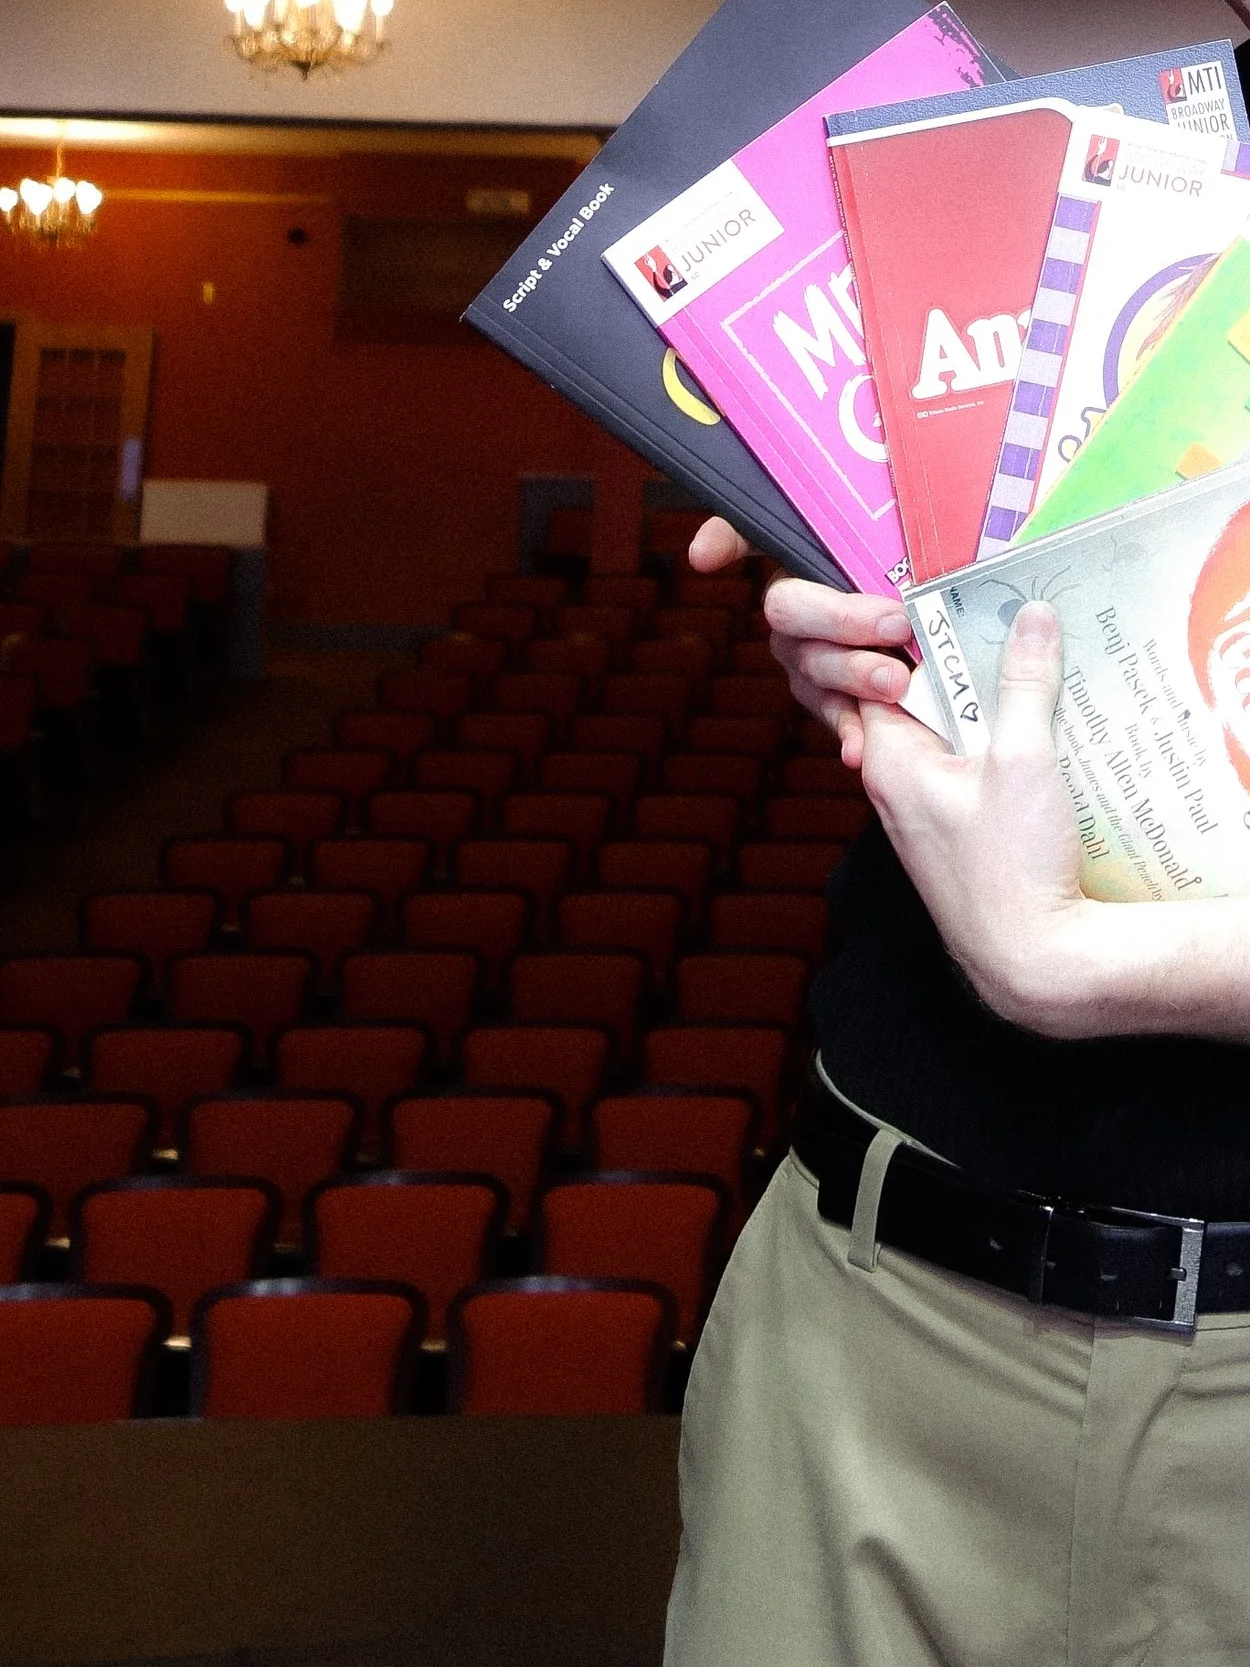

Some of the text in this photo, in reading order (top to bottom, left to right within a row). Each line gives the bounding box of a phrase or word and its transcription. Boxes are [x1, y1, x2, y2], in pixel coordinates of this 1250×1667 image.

[1171, 97, 1225, 120] BROADWAY
[1187, 65, 1222, 95] MTI
[1118, 163, 1204, 198] JUNIOR
[503, 182, 615, 313] Script & Vocal Book
[681, 208, 757, 272] JUNIOR
[1095, 605, 1131, 656] Benj
[1118, 652, 1157, 716] Pasek
[1153, 731, 1191, 791] Justin
[1184, 787, 1218, 836] Paul
[1142, 638, 1169, 682] Words
[1161, 684, 1184, 710] and
[1193, 748, 1208, 767] by
[1063, 665, 1191, 891] Timothy Allen McDonald
[1124, 723, 1153, 779] Book by
[1064, 724, 1085, 757] book
[1077, 757, 1102, 792] James
[1096, 791, 1118, 815] and
[1107, 813, 1124, 834] the
[1117, 832, 1142, 860] Giant
[1133, 858, 1161, 892] Peach
[1077, 813, 1111, 861] Dahl
